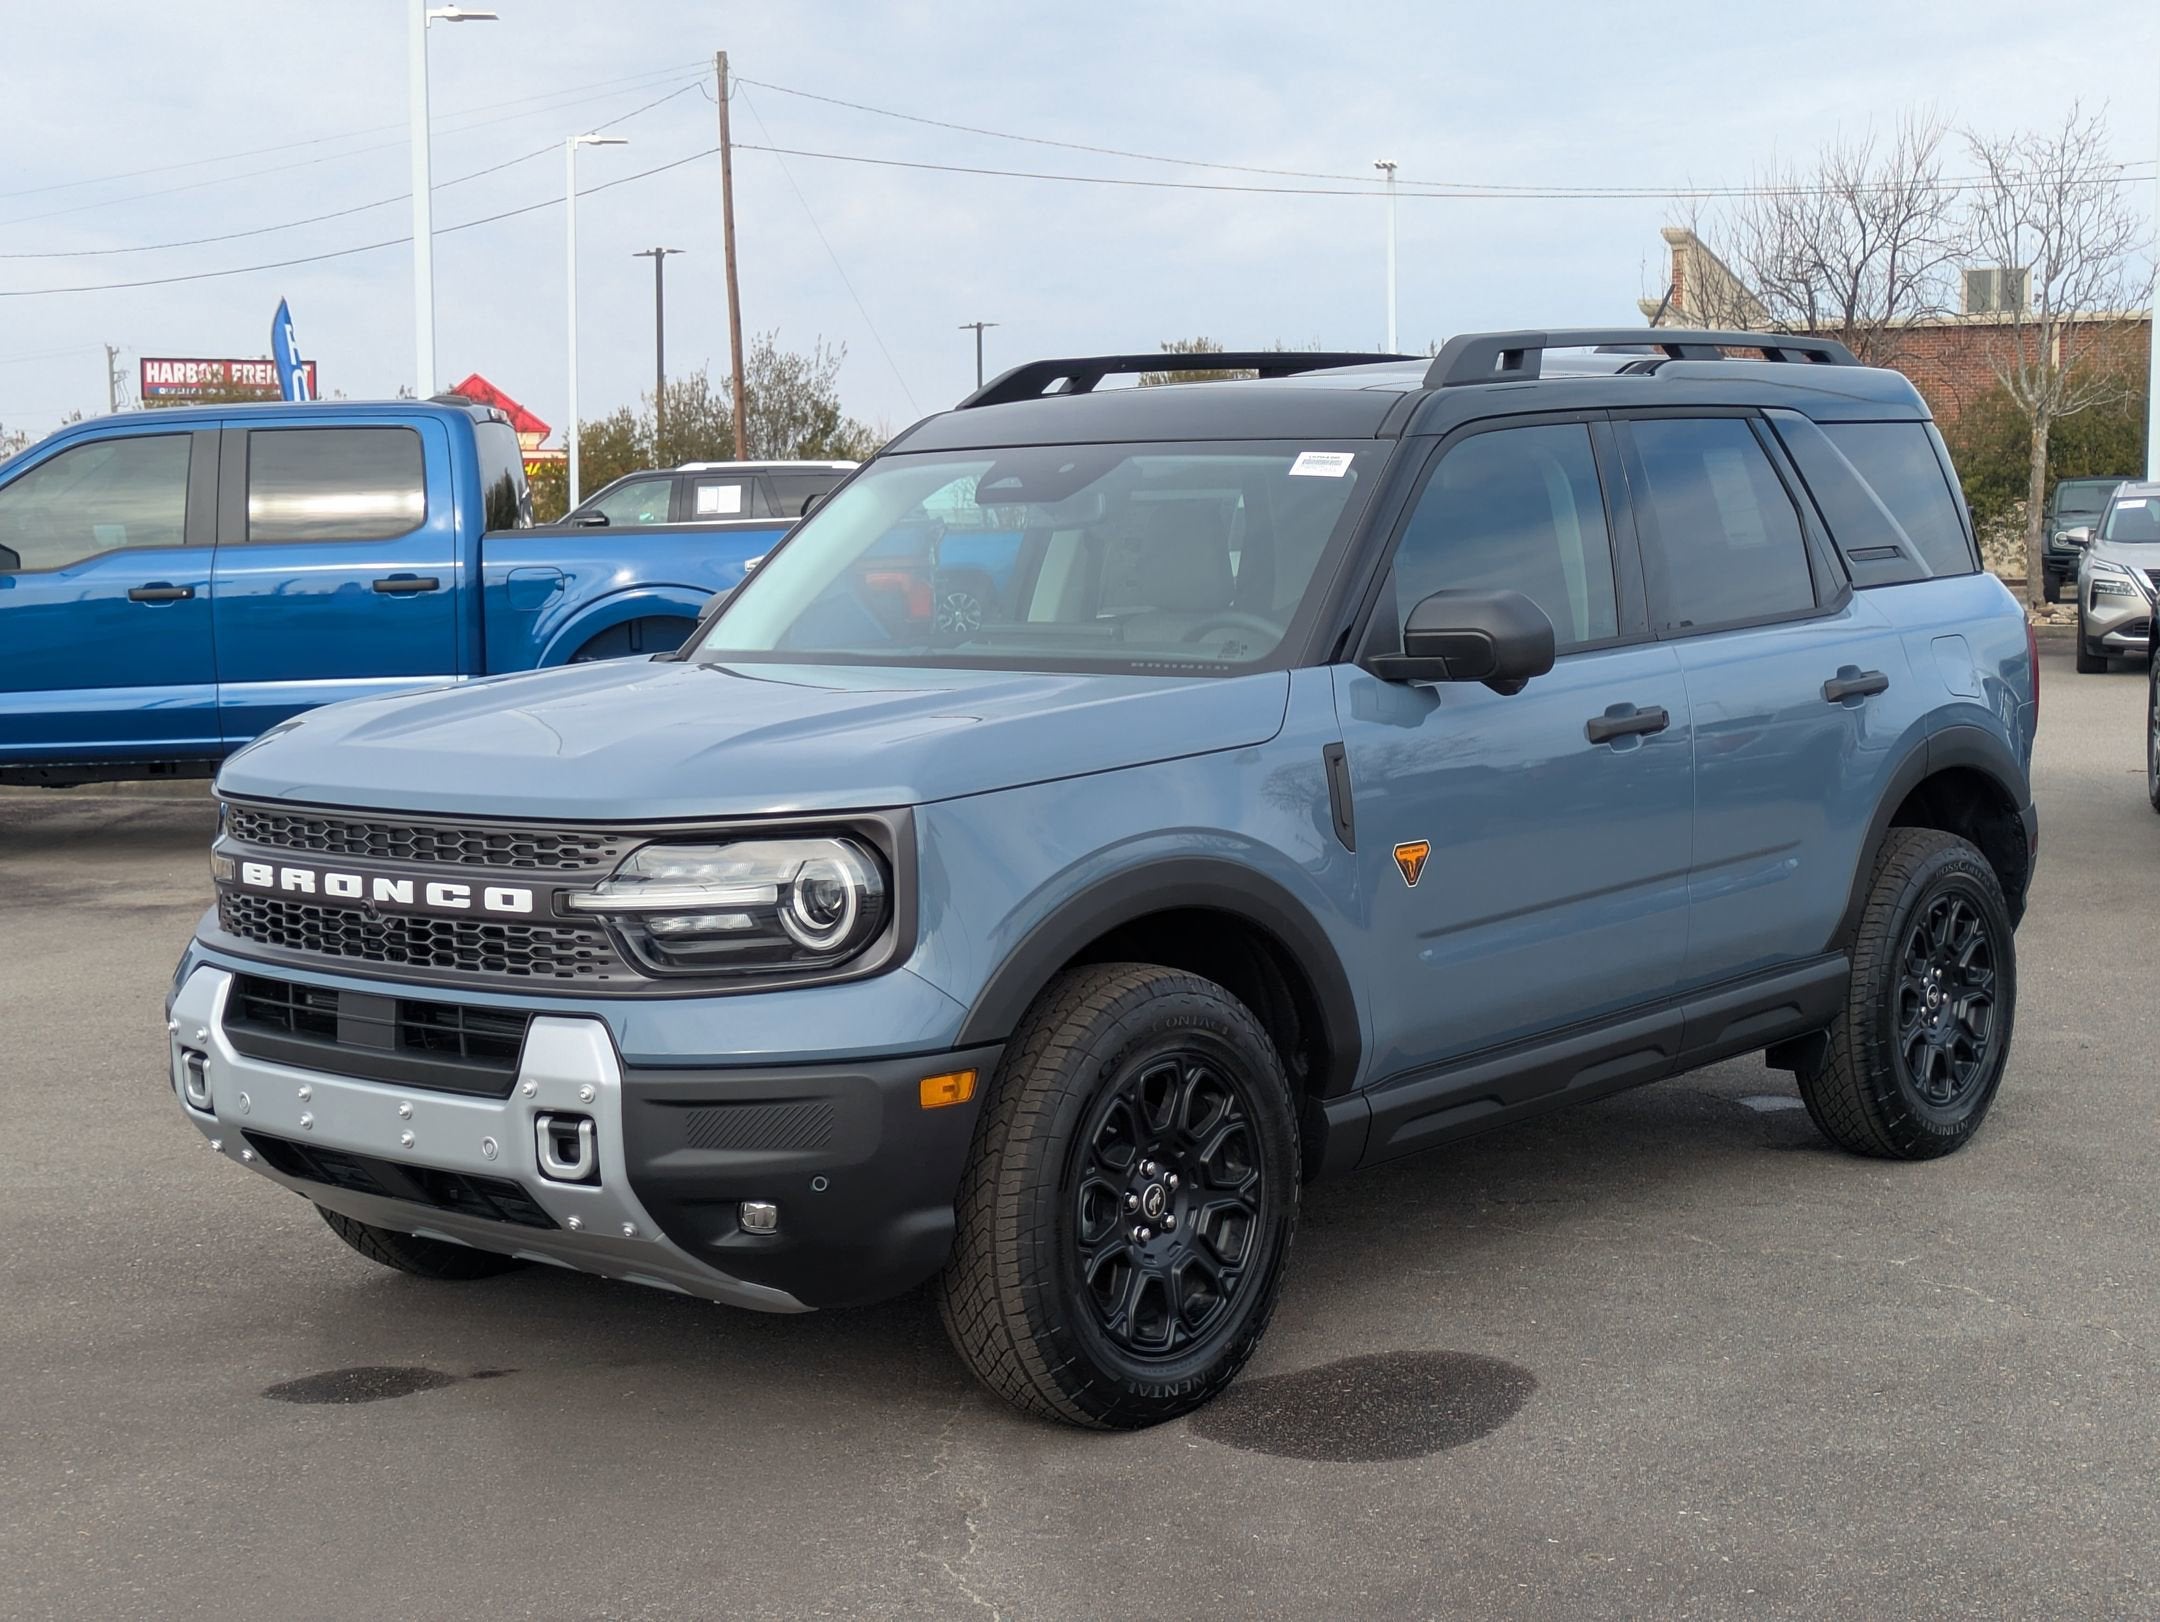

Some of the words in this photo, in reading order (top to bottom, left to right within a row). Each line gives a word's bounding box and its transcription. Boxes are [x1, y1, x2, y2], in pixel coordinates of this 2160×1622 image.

[146, 362, 224, 384] HARBOR
[231, 363, 311, 386] FREIT
[242, 862, 533, 913] BRONCO
